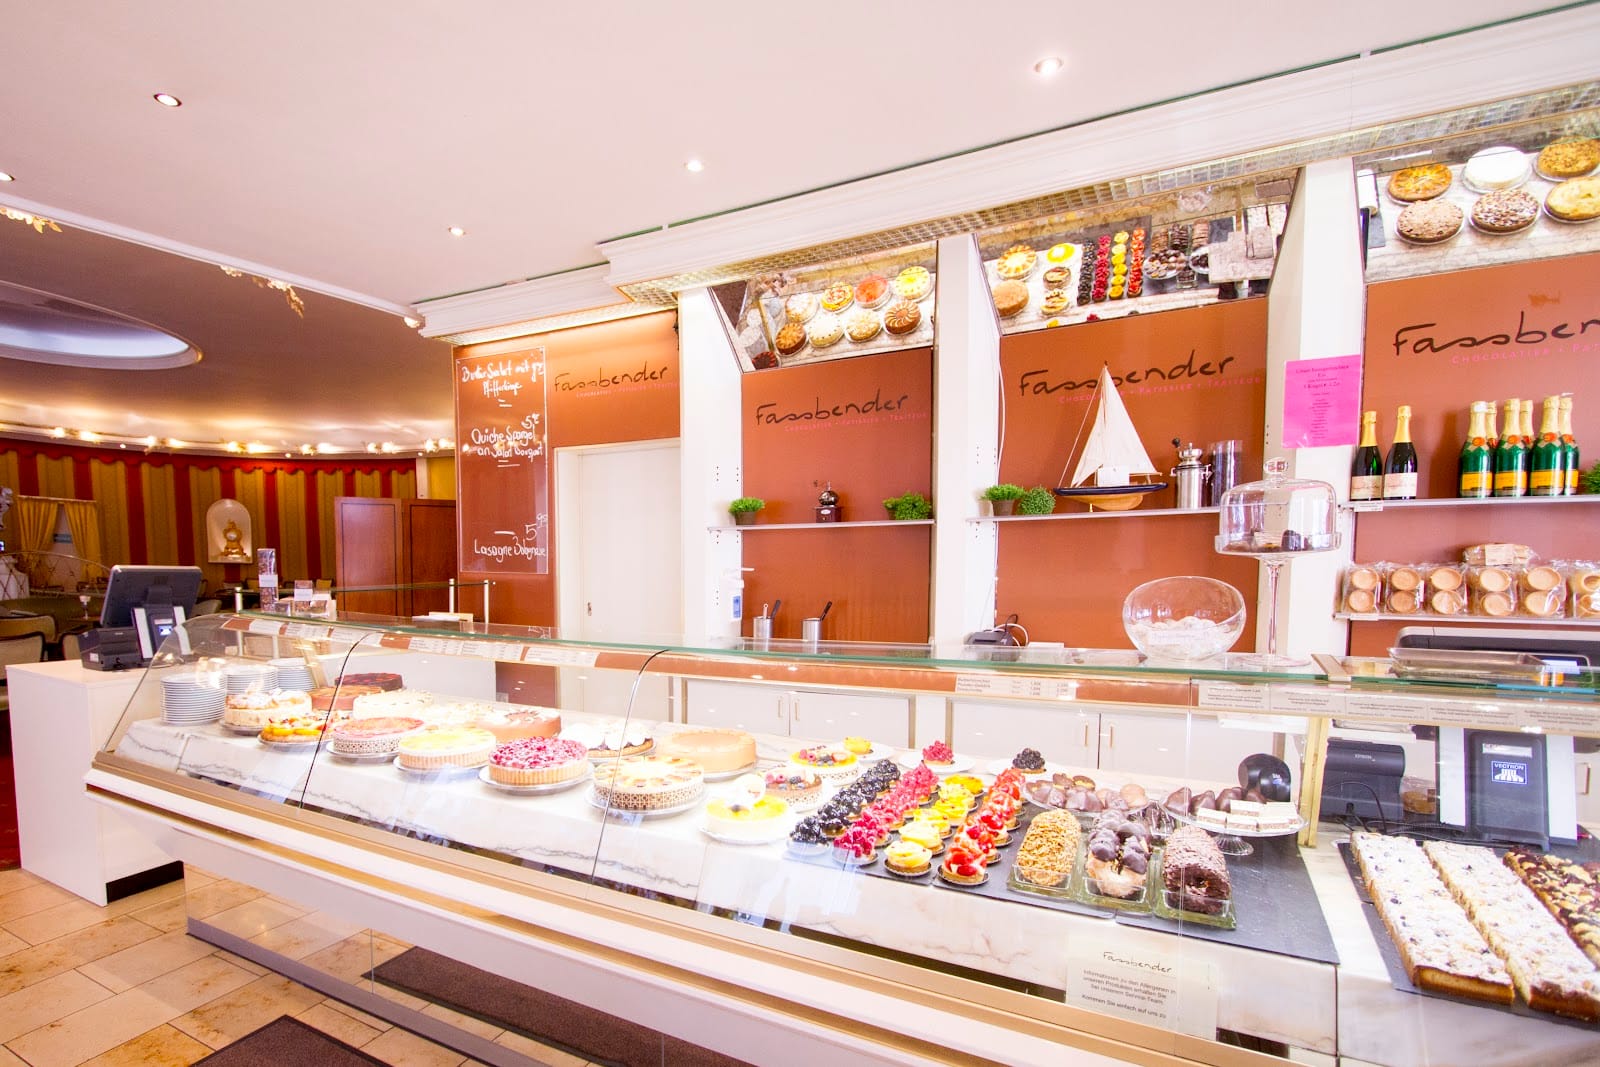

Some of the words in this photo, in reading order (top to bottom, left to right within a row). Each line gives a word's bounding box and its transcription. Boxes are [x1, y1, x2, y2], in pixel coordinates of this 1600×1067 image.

[554, 360, 669, 393] Fassbender
[755, 388, 909, 426] Fassbender
[471, 427, 507, 445] Quiche
[506, 424, 536, 447] Spargel
[477, 447, 491, 456] an
[474, 539, 513, 563] Lasagne
[1494, 762, 1525, 770] VECTRON
